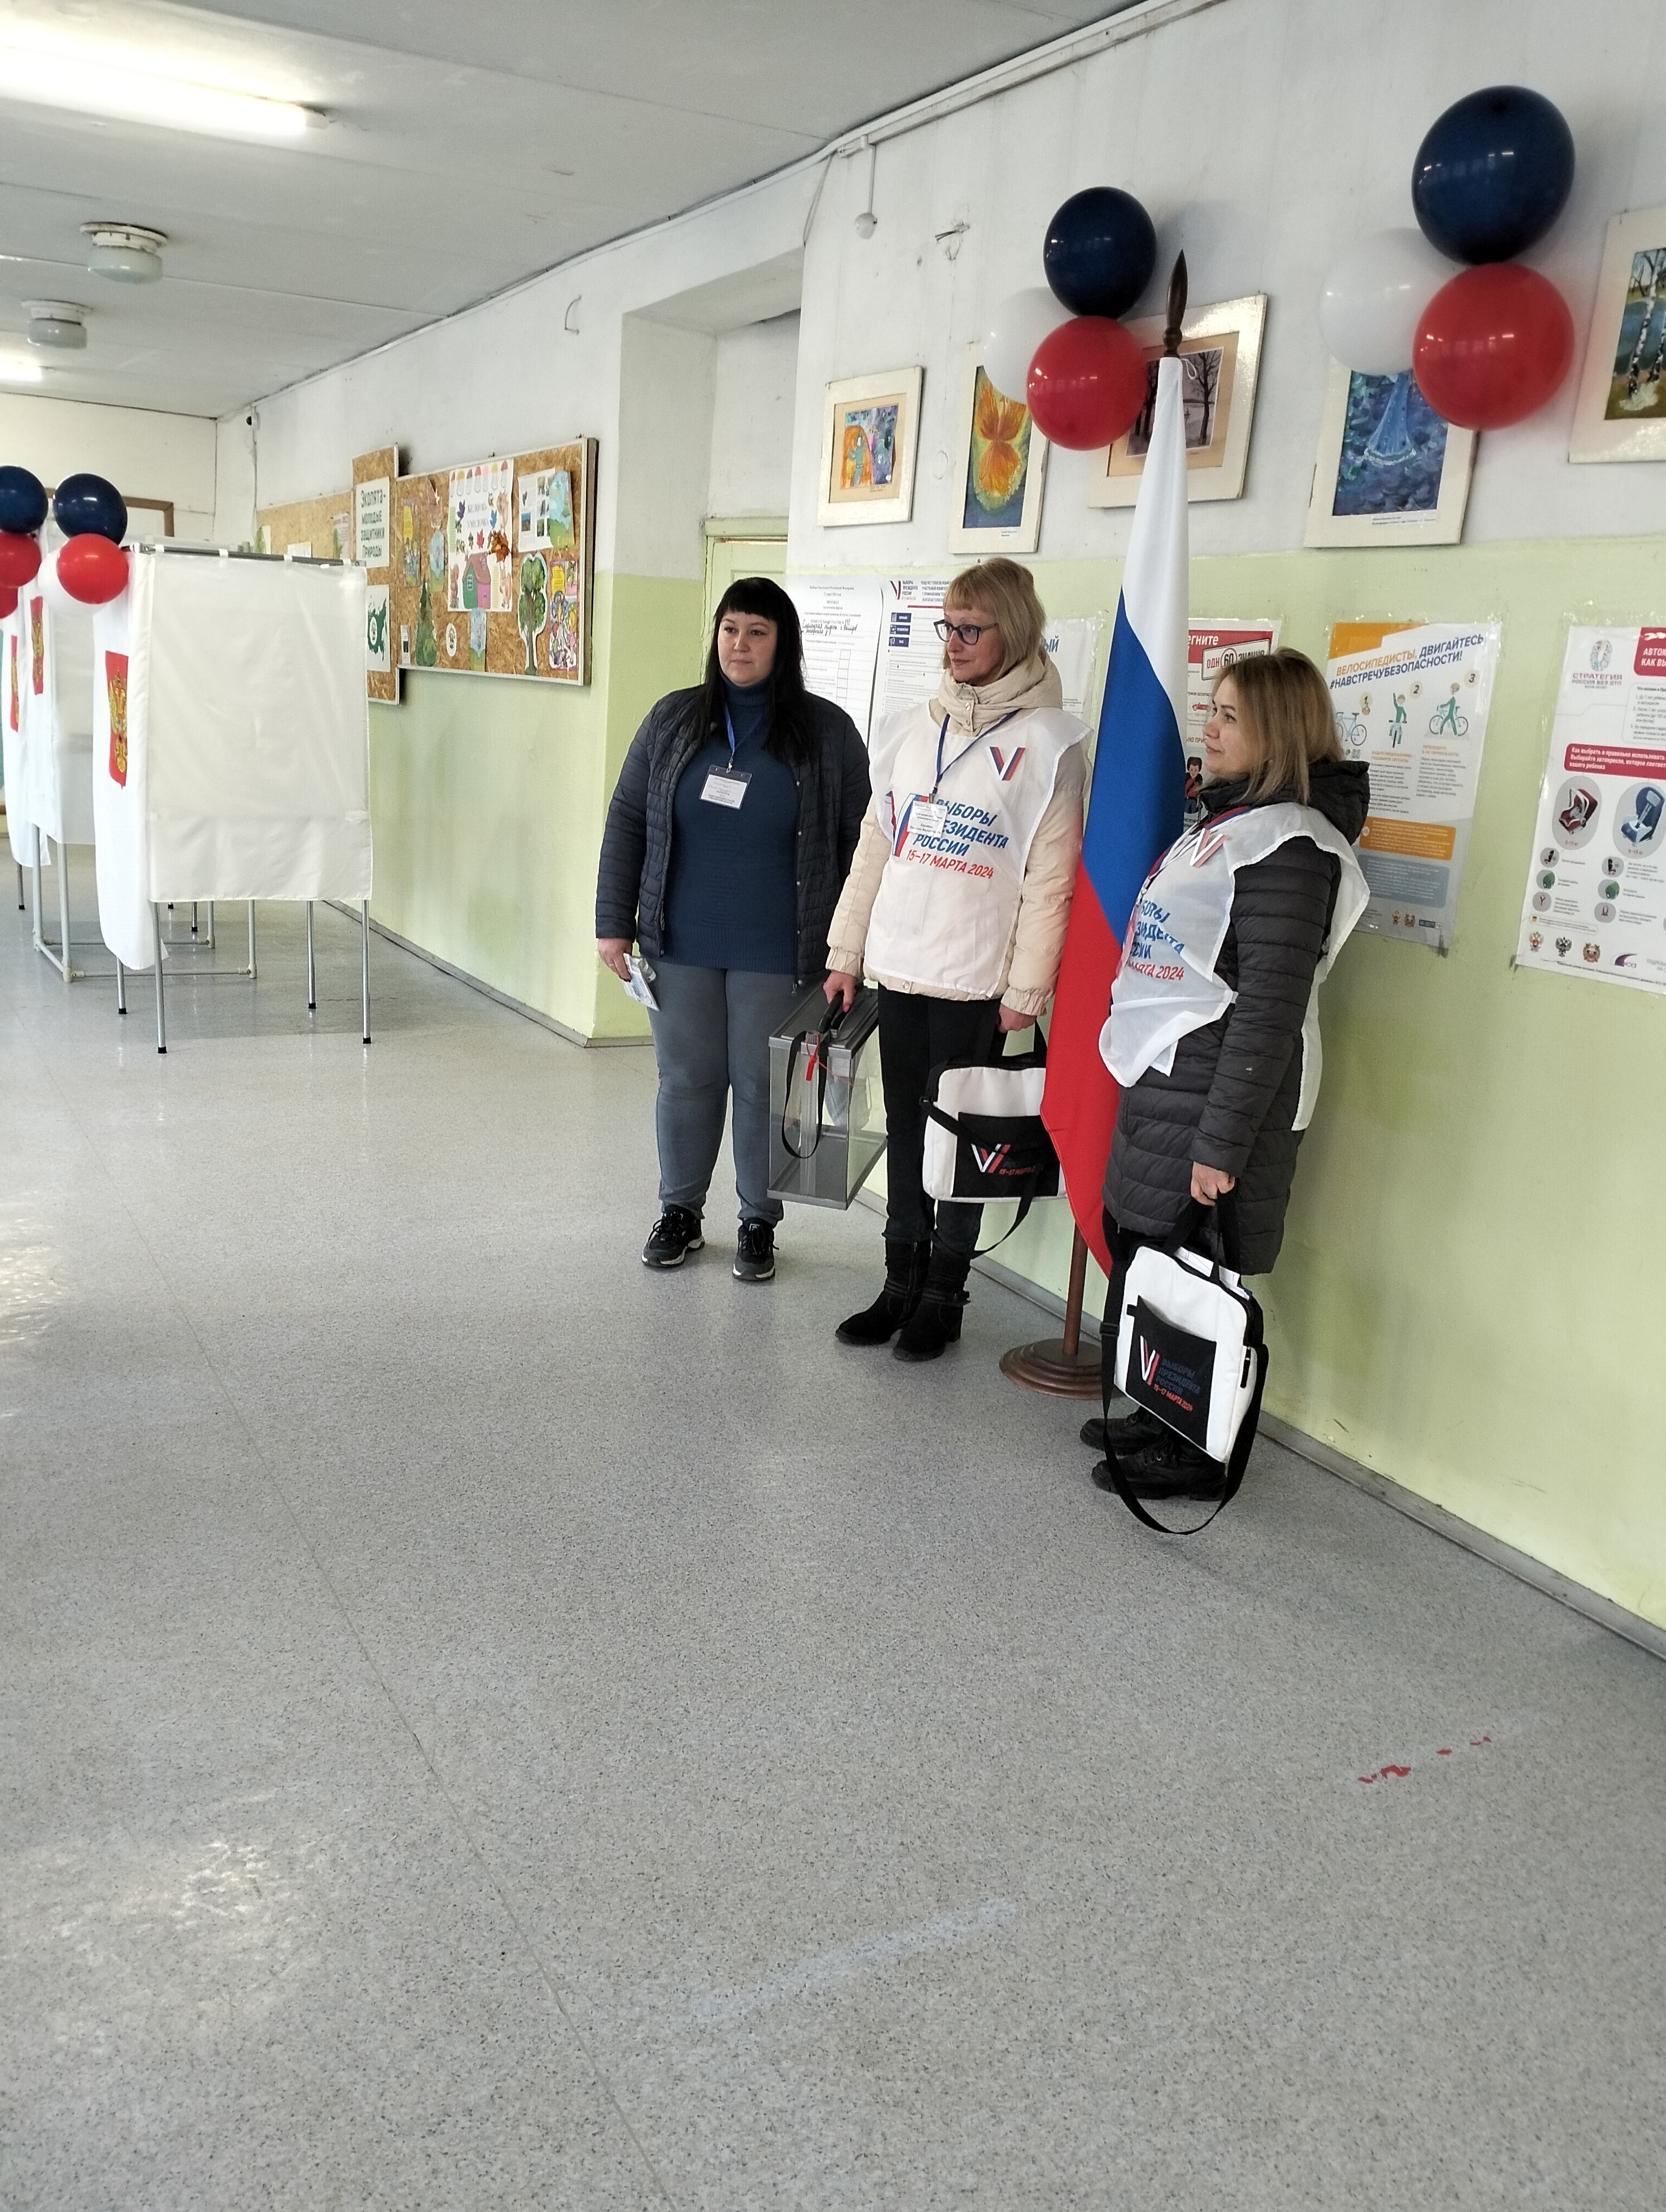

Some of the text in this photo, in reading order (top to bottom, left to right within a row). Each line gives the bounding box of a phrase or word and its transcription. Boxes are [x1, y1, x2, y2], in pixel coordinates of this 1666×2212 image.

[1419, 634, 1484, 659] ДВИГАЙТЕСЬ
[1330, 651, 1463, 690] #НАВСТРЕЧУБЕЗОПАСНОСТИ!
[1641, 658, 1656, 666] КАК
[1469, 673, 1476, 683] 3
[1413, 684, 1420, 694] 2
[1363, 696, 1368, 705] 1
[941, 820, 1009, 848] ЕЗИДЕНТА
[913, 834, 970, 857] РОССИИ
[930, 855, 967, 872] МАРТА
[967, 864, 994, 879] 2024
[1156, 966, 1185, 980] 2024
